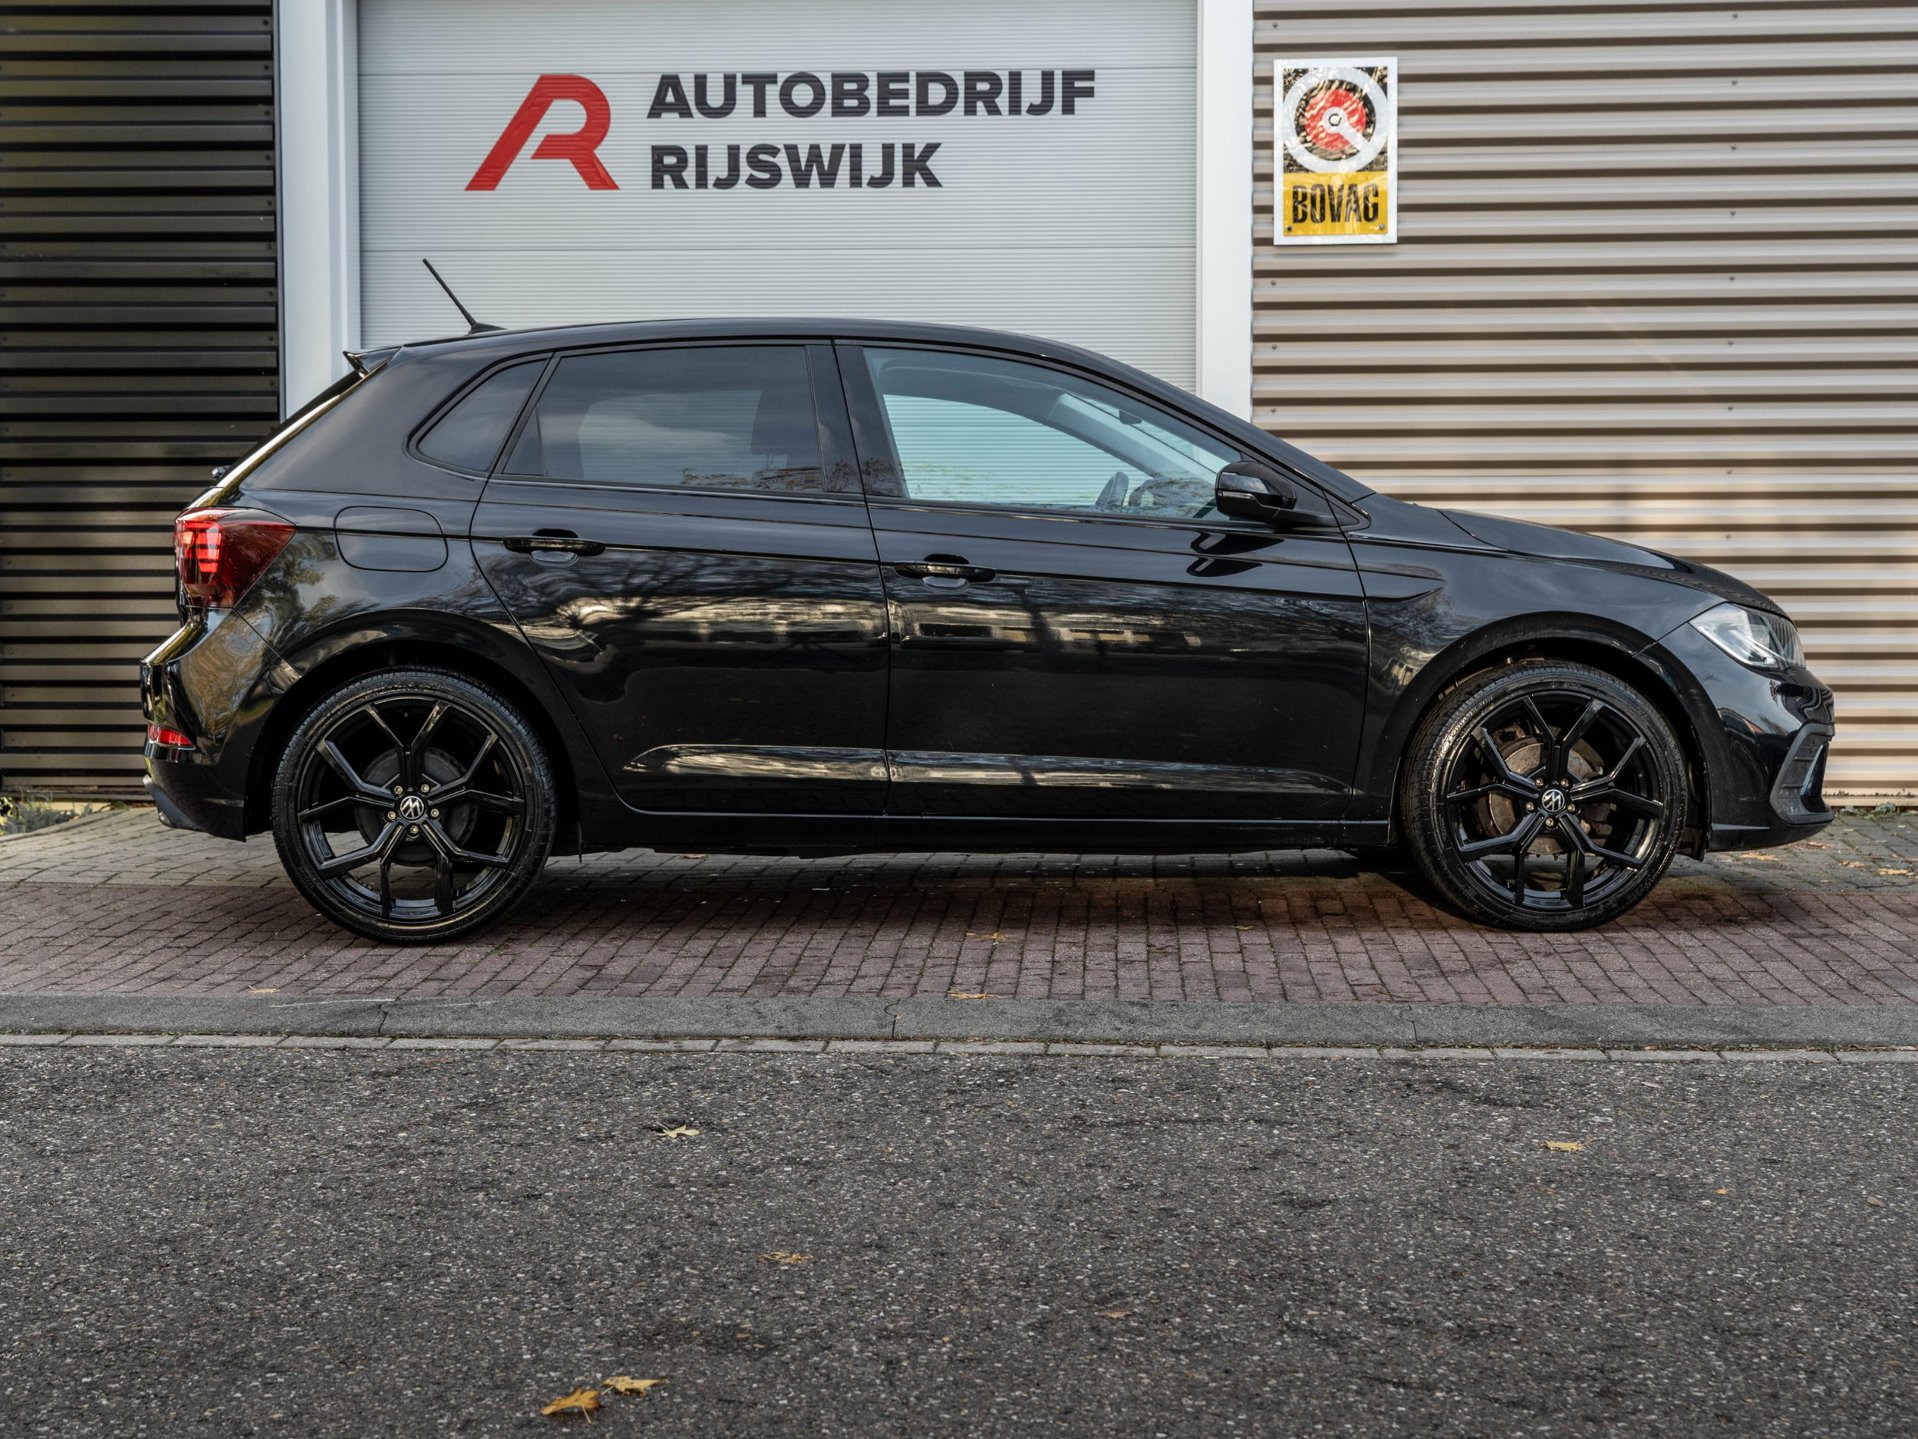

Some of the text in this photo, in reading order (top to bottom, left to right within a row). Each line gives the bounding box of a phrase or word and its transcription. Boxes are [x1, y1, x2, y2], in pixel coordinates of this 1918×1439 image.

[647, 69, 1095, 119] AUTOBEDRIJF
[650, 142, 943, 190] RIJSWIJK
[1292, 183, 1379, 224] BOVAG
